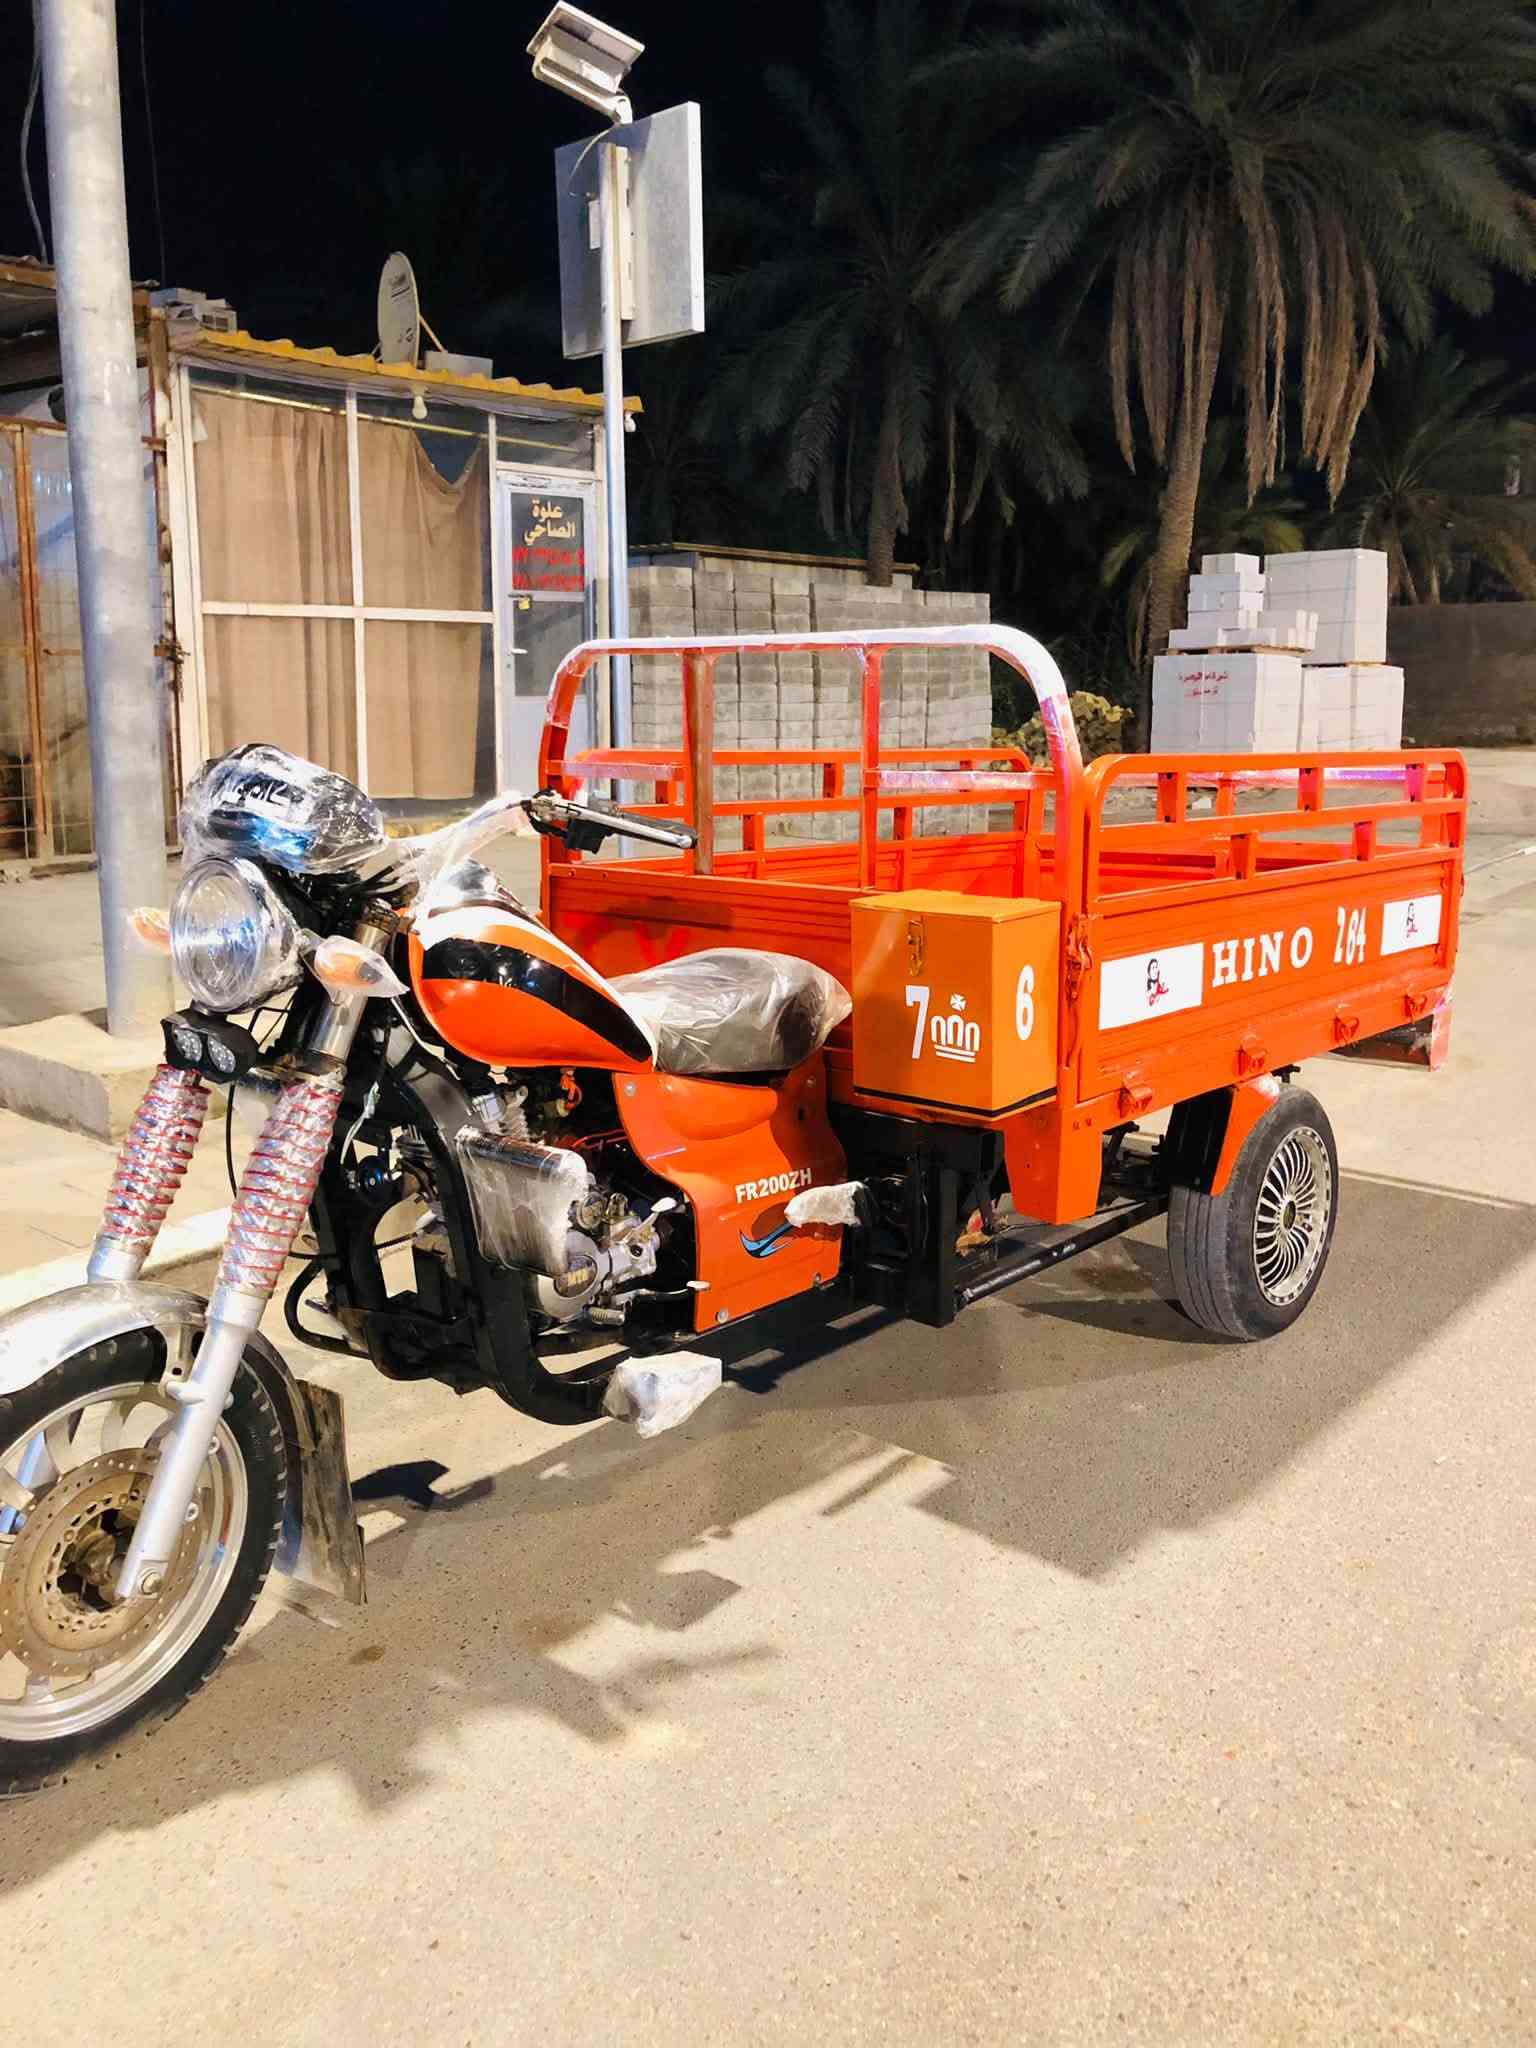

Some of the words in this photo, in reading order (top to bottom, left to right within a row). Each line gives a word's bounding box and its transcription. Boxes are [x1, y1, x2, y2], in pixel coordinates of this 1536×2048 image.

[532, 499, 562, 522] علوة
[1212, 926, 1314, 988] HINO
[1015, 964, 1035, 1041] 6
[735, 1167, 813, 1204] FR200ZH
